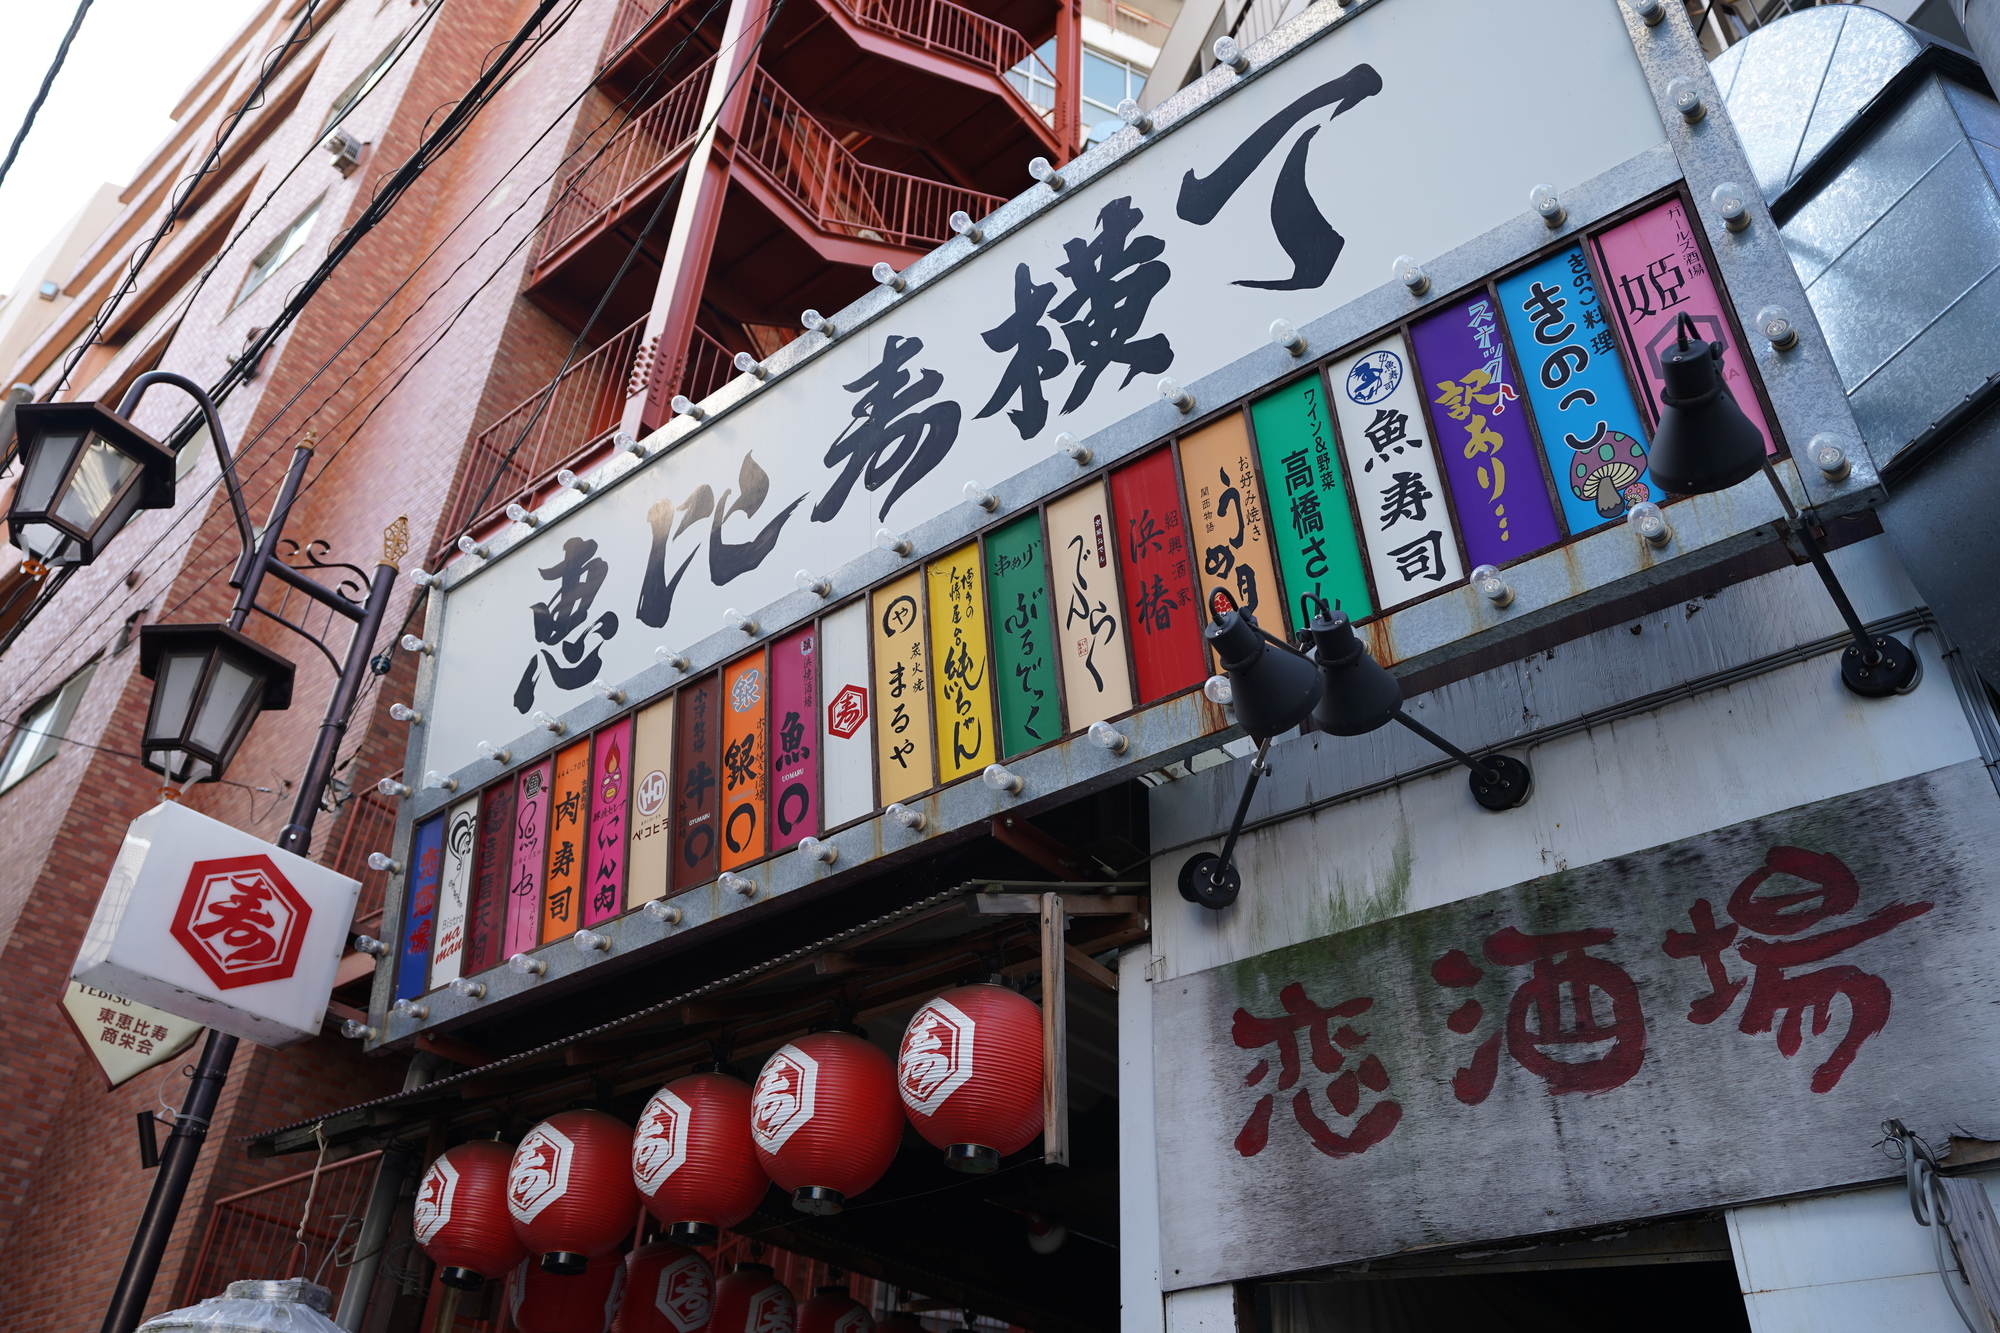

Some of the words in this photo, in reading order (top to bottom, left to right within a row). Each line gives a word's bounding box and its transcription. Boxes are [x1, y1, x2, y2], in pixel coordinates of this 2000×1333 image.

[1667, 206, 1705, 280] ガールズ酒場
[1567, 253, 1615, 356] きのこ料理
[1619, 254, 1691, 326] 姫
[1383, 360, 1399, 391] 魚寿司
[1467, 299, 1504, 385] スナック
[1522, 281, 1607, 452] きのこ
[514, 63, 1382, 713] 恵比寿横丁
[1303, 388, 1336, 492] ワイン&野菜
[1238, 456, 1263, 542] お好み焼き
[1364, 408, 1446, 583] 魚寿司
[1128, 509, 1172, 636] 浜椿
[1164, 509, 1192, 607] 紹興酒家
[732, 669, 761, 712] 銀
[910, 642, 925, 694] 炭火焼
[836, 693, 861, 731] 寿
[888, 662, 915, 769] まるや
[781, 767, 805, 783] UOMARU
[549, 791, 581, 923] 肉寿司
[688, 812, 711, 826] GYUMARU
[408, 846, 440, 955] 恋酒場
[441, 914, 464, 931] Bistro
[468, 836, 497, 970] 達磨天狗
[97, 1007, 169, 1042] 東恵比寿
[100, 1027, 154, 1056] 商栄会
[1231, 845, 1935, 1158] 恋酒場
